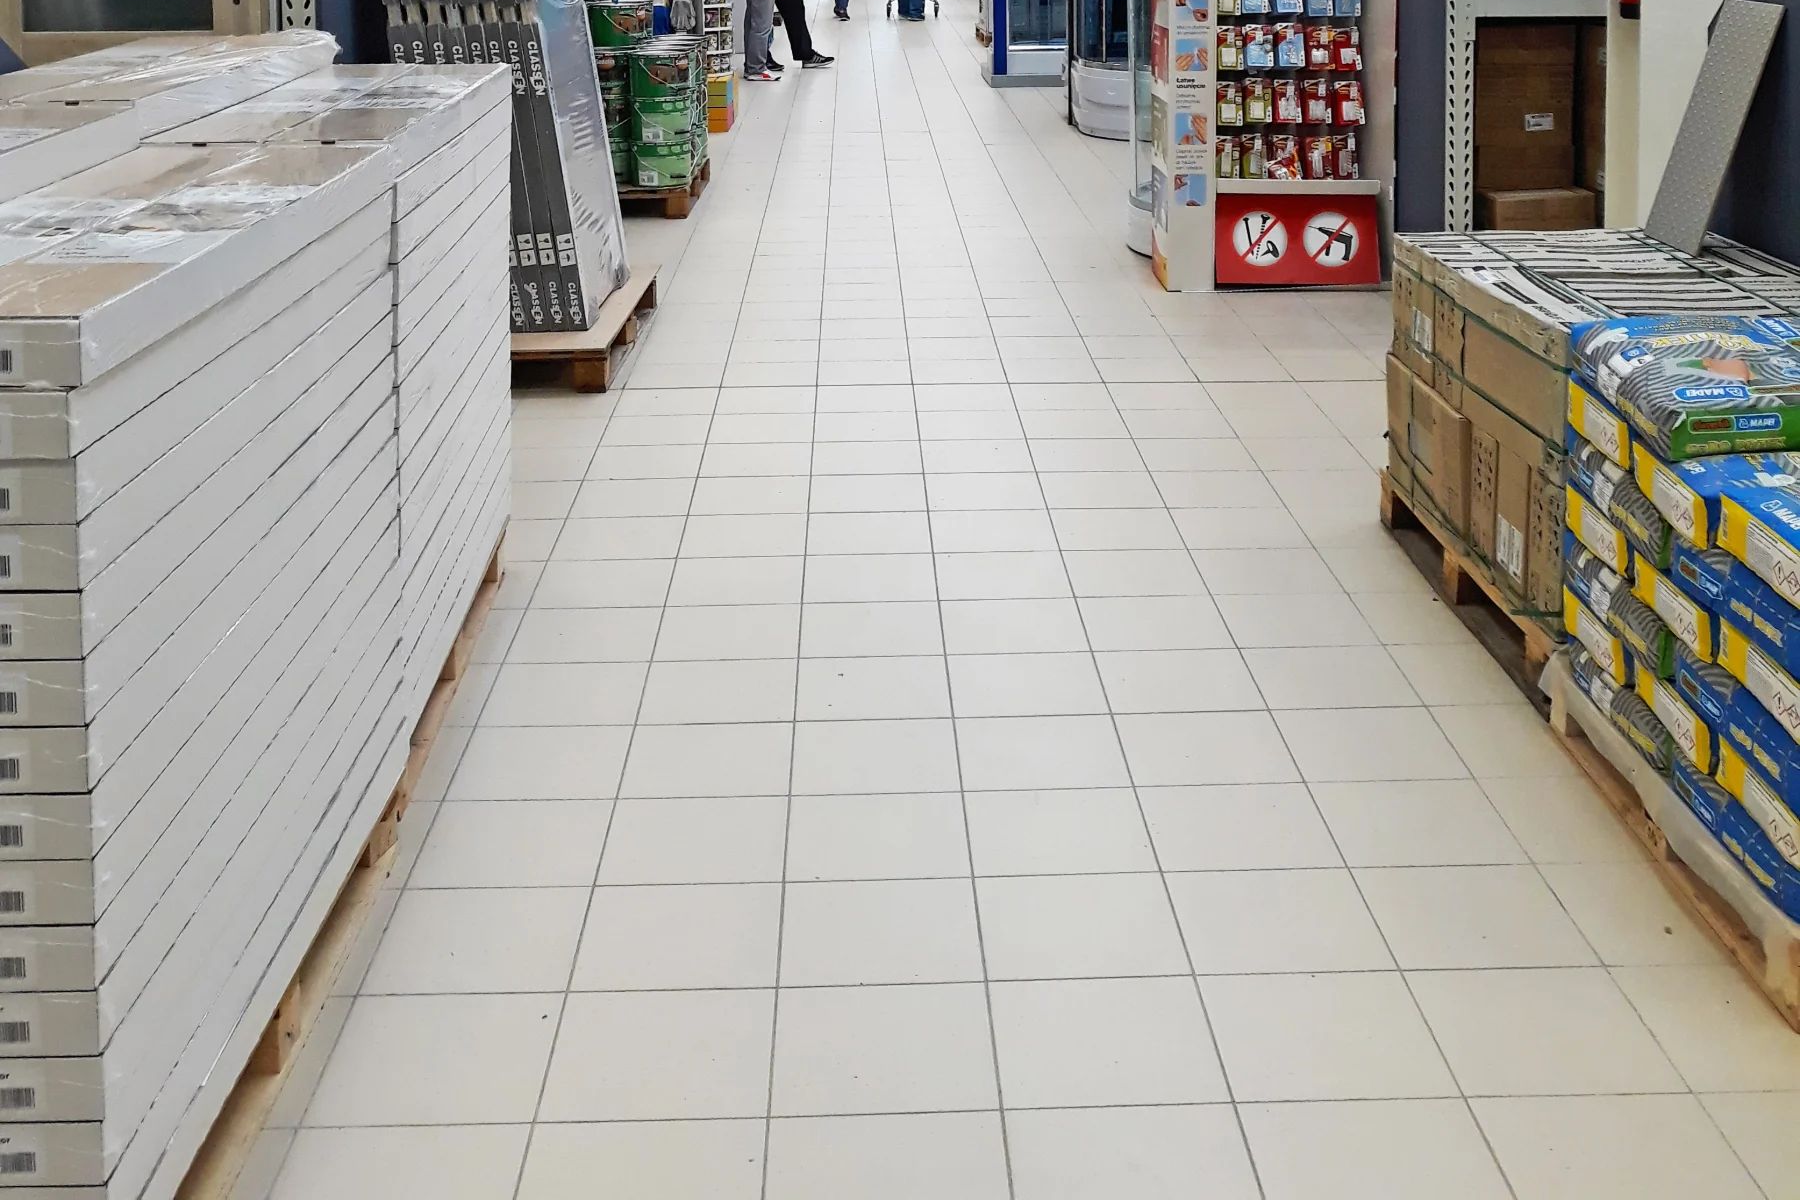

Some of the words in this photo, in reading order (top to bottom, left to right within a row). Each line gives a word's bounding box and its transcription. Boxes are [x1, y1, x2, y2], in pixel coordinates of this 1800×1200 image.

[527, 41, 545, 96] CLASSEN
[549, 281, 562, 324] CLASSEN
[568, 282, 582, 324] CLASSEN
[1750, 418, 1776, 427] MAPEI
